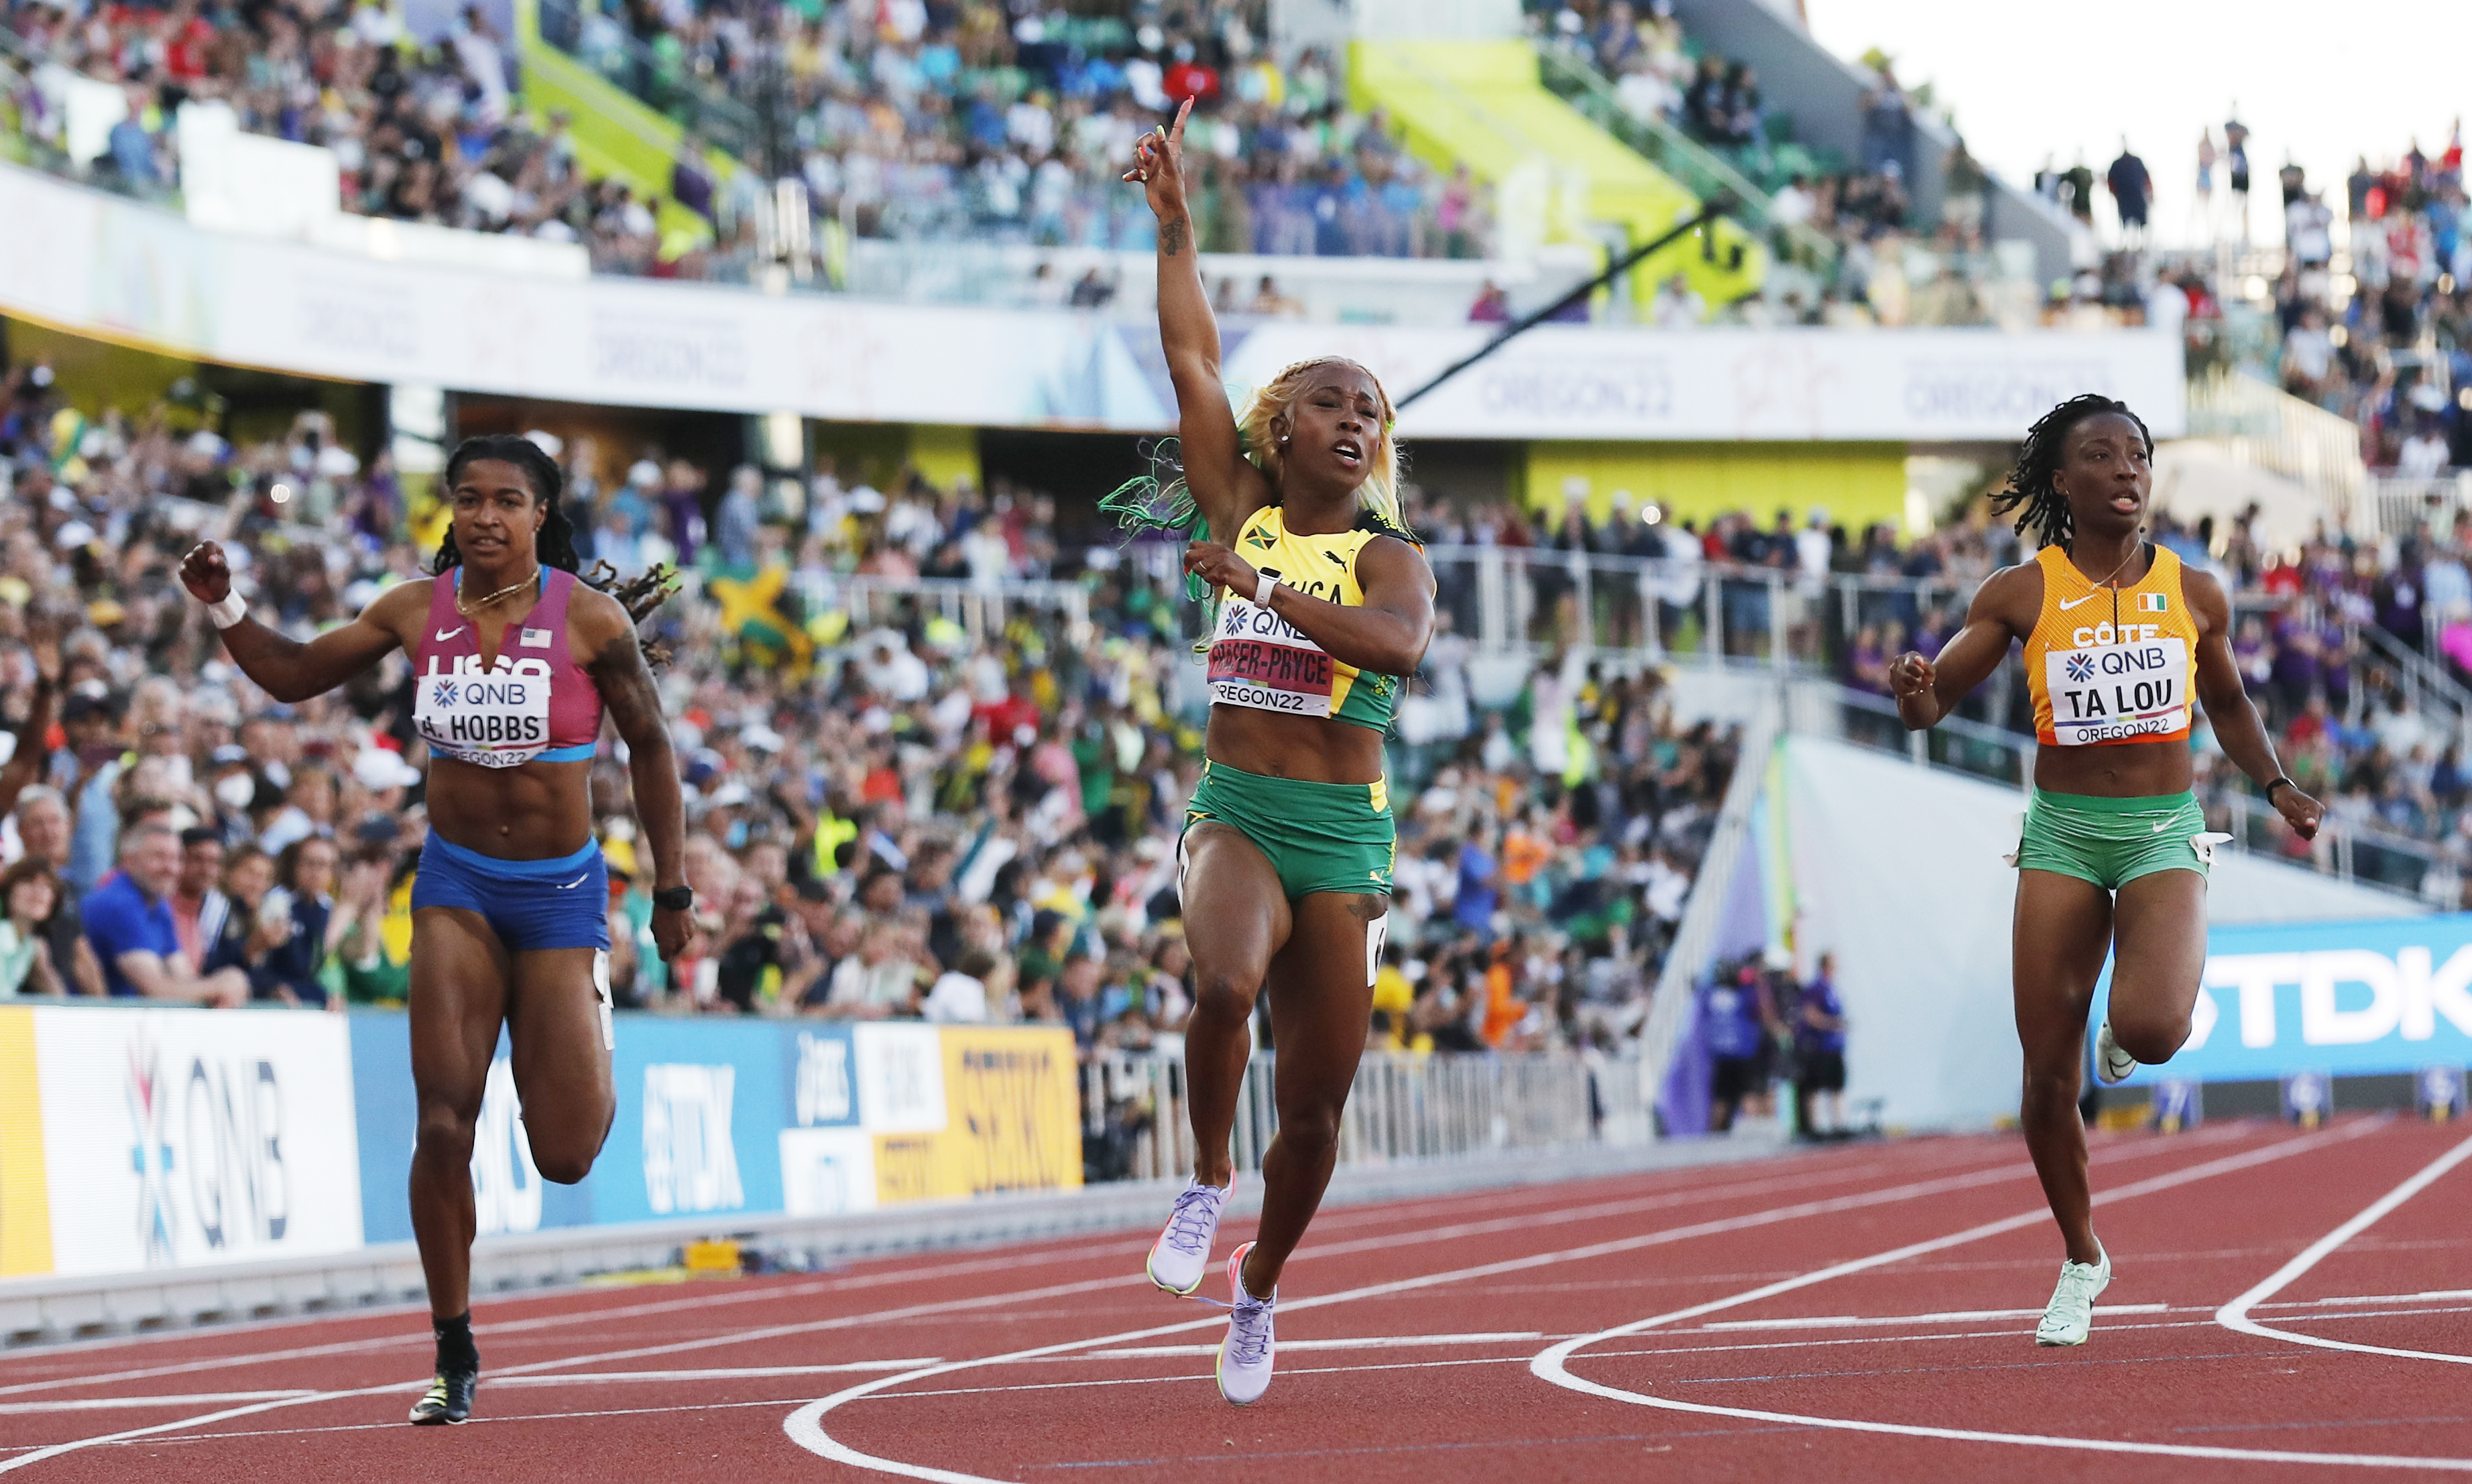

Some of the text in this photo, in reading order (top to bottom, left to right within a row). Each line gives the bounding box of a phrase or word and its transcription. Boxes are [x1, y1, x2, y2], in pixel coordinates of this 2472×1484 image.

[2072, 621, 2160, 648] CÔTE
[2101, 647, 2166, 674] QNB
[465, 683, 526, 704] QNB
[1213, 684, 1304, 710] REGON22
[2064, 679, 2172, 718] TA LOU
[451, 715, 540, 742] HOBBS
[2076, 718, 2169, 742] OREGON22
[186, 1057, 290, 1248] QNB
